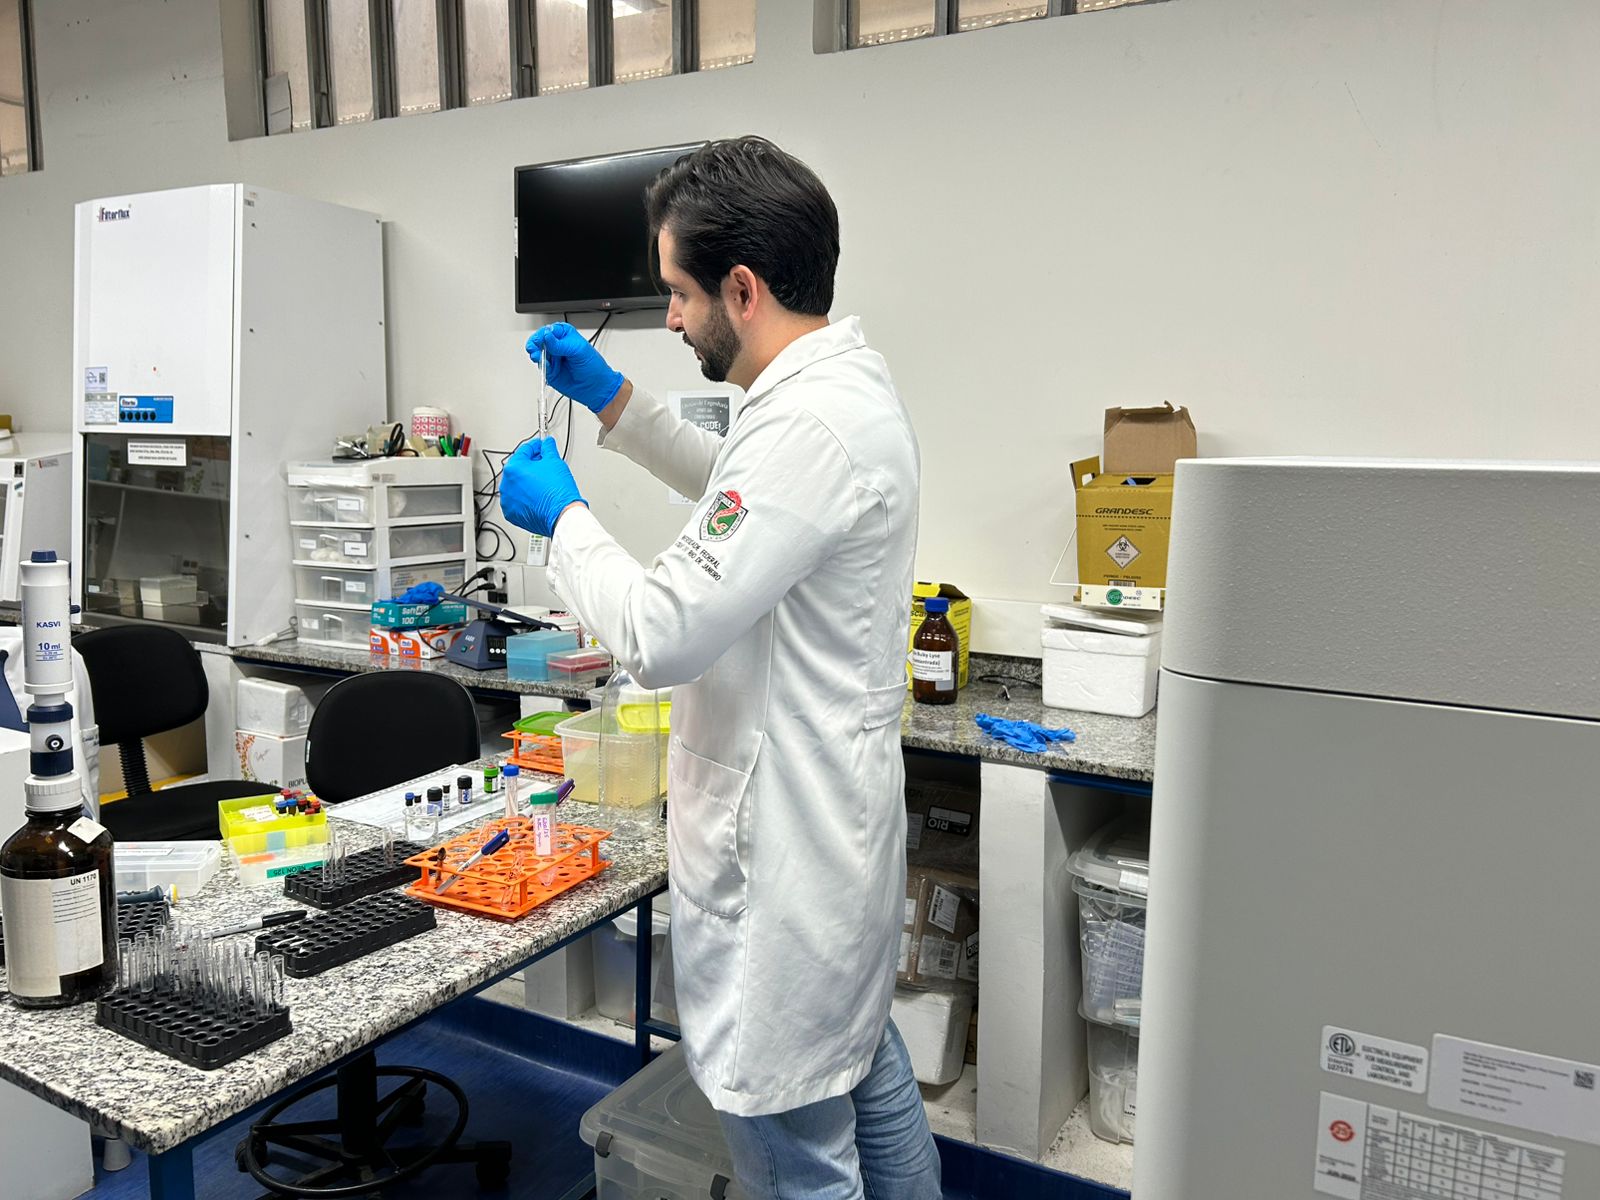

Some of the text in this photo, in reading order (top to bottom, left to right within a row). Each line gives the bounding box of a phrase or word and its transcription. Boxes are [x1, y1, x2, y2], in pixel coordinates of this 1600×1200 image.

[1095, 507, 1154, 515] GRANDESC
[700, 549, 720, 570] FEDERAL
[701, 563, 722, 581] JANEIRO
[36, 621, 61, 629] KASVI
[402, 617, 415, 625] 100
[38, 642, 50, 651] 10
[928, 818, 949, 831] RIO
[70, 872, 97, 886] UN 1170
[1361, 1045, 1424, 1064] ELECTRICAL EQUIPMENT
